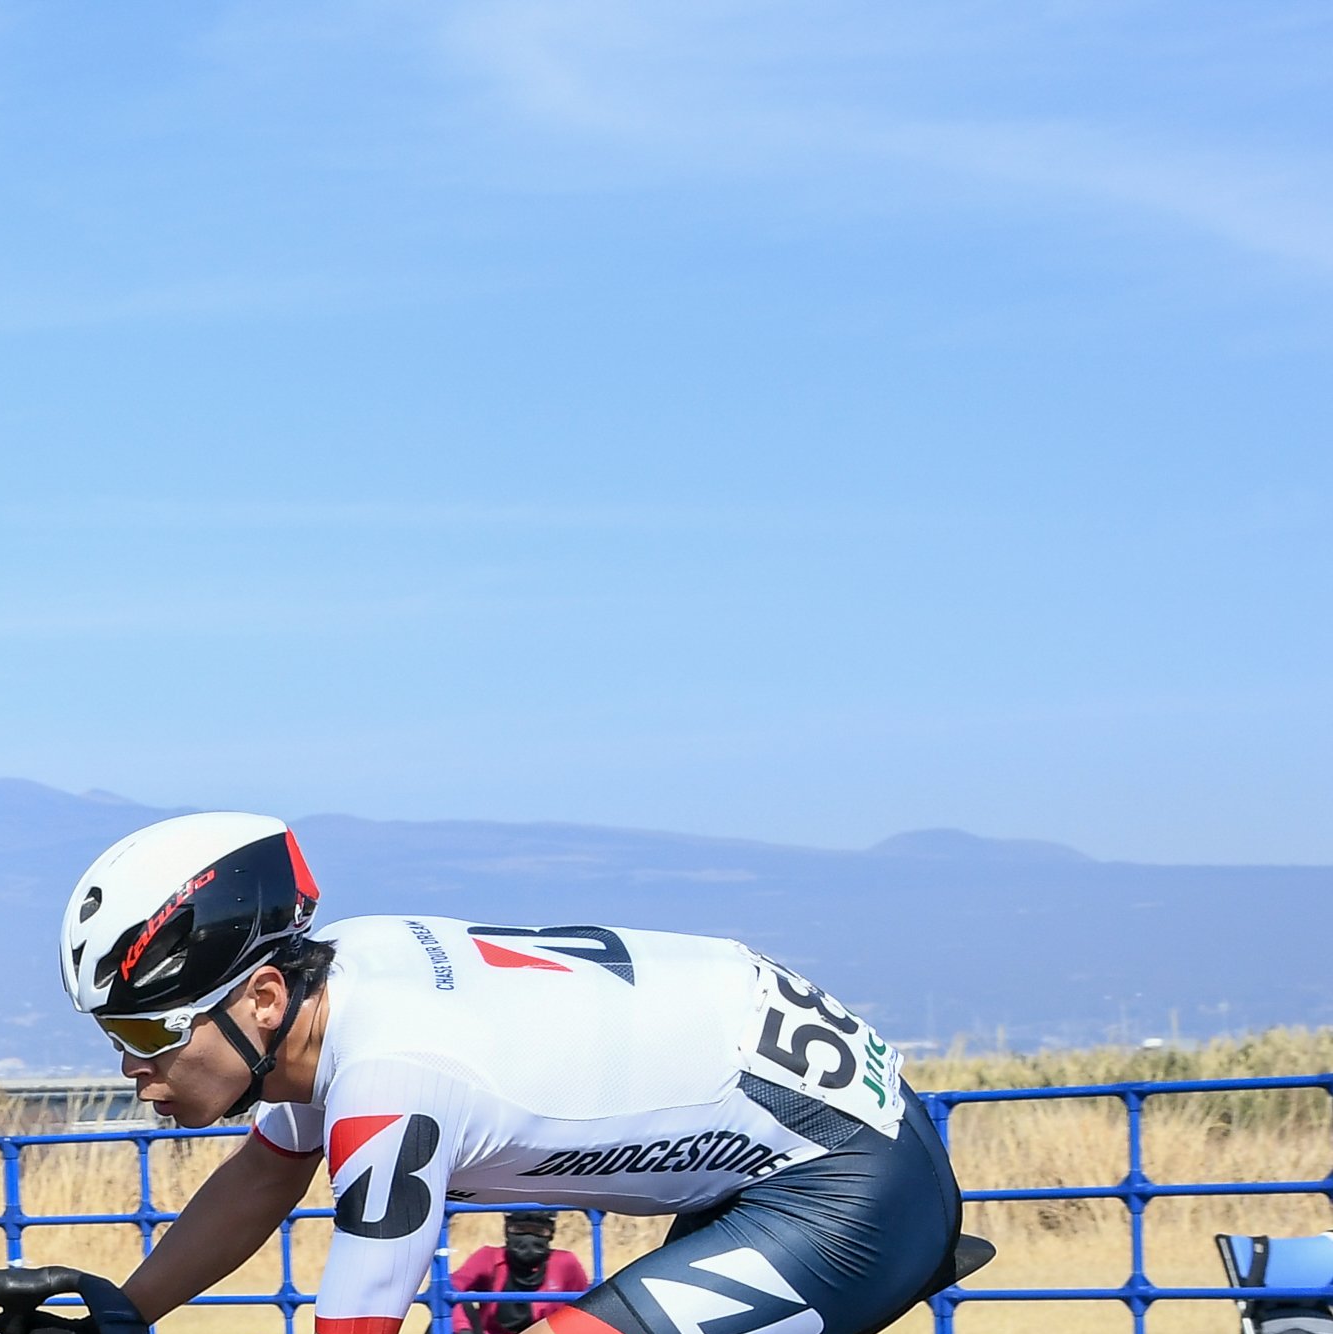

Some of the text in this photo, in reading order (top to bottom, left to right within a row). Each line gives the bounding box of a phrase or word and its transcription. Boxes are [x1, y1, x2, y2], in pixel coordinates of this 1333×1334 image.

[120, 868, 216, 982] Kabuto
[403, 919, 455, 990] CHASE YOUR DREAM
[756, 969, 860, 1090] 58
[516, 1130, 793, 1178] BRIDGESTONE
